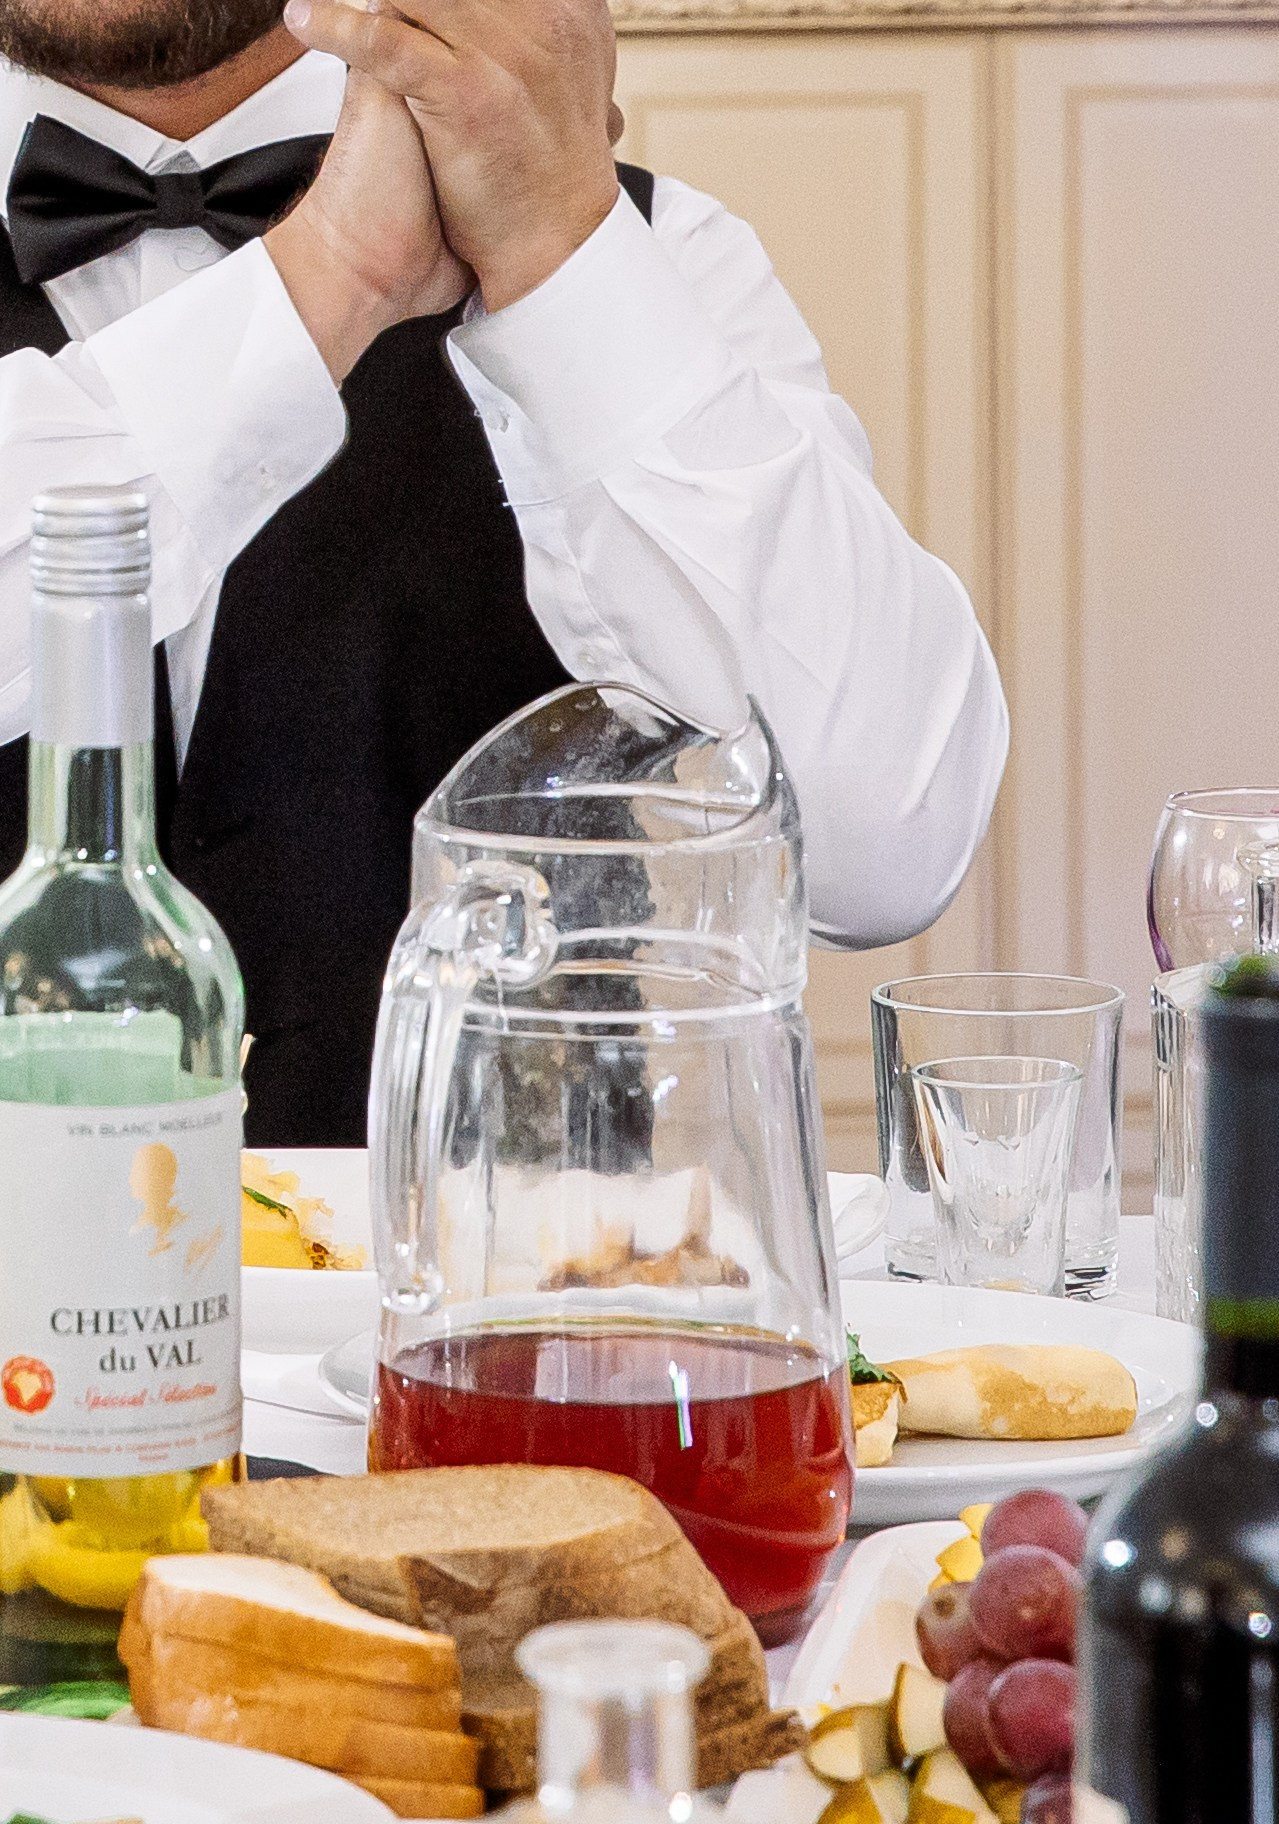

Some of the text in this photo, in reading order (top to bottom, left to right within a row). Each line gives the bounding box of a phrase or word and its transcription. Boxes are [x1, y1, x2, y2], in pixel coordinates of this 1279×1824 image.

[50, 1292, 230, 1337] CHEVALIER
[98, 1337, 204, 1373] du VAL
